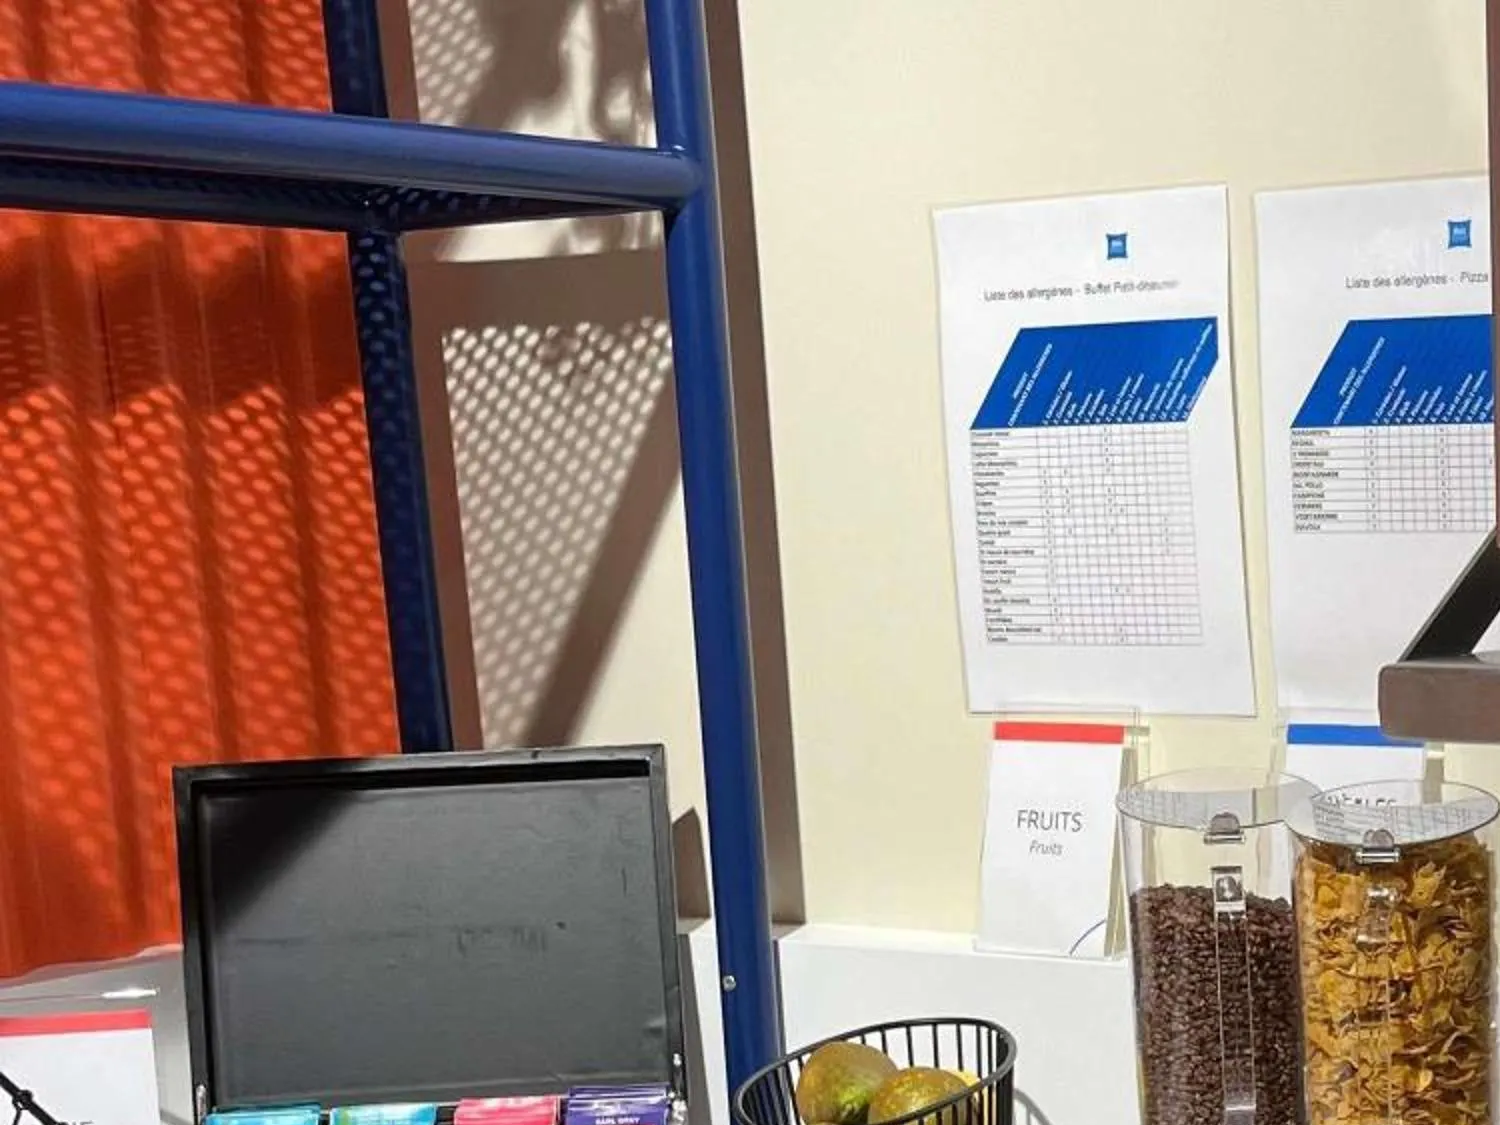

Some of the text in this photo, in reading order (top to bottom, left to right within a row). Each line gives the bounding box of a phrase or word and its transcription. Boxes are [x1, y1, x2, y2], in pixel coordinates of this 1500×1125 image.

[1345, 276, 1371, 289] Liste
[1373, 275, 1392, 288] des
[1008, 287, 1025, 300] des
[1016, 809, 1083, 832] FRUITS
[1029, 839, 1063, 855] Fruits
